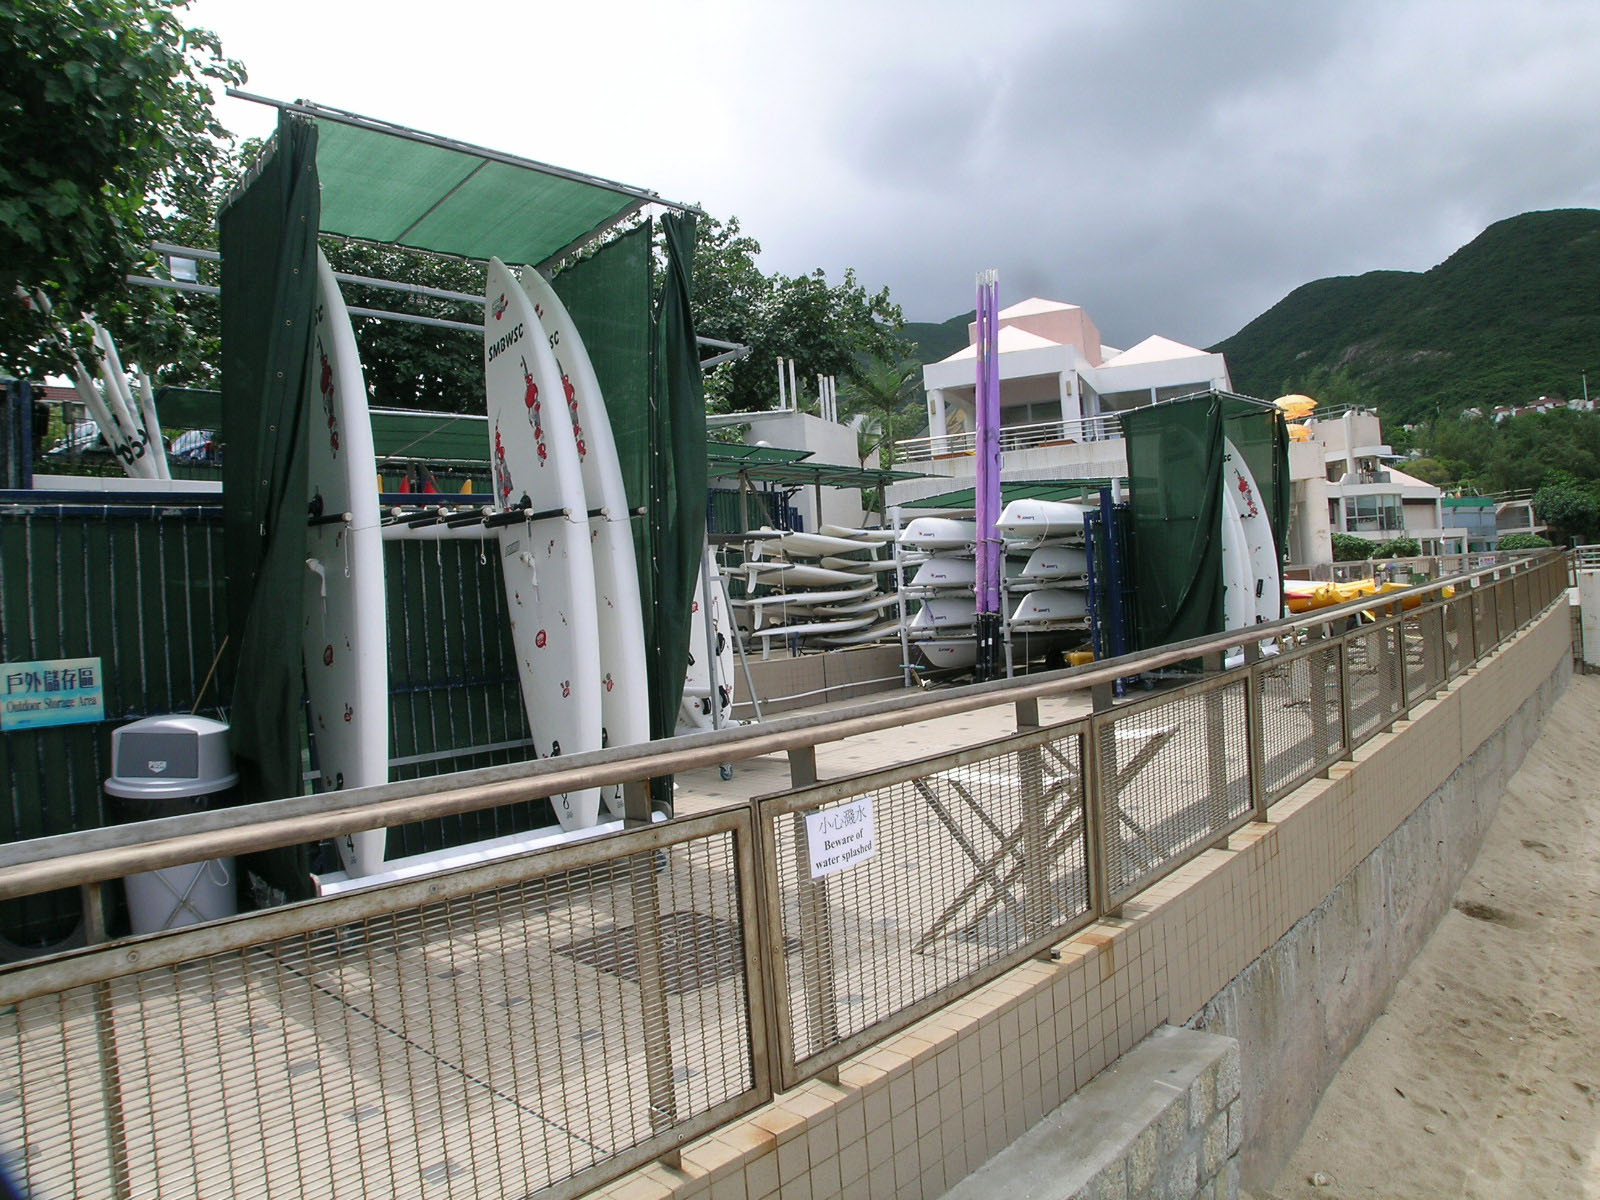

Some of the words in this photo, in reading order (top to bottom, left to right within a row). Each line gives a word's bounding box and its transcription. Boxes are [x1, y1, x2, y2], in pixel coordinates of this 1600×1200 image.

[488, 322, 524, 362] SMBWSC
[7, 700, 41, 713] Outdoor
[44, 697, 75, 710] Storage
[80, 696, 97, 707] Area
[824, 834, 854, 851] Beware
[856, 828, 864, 840] of
[816, 854, 841, 870] water
[842, 841, 872, 862] splashed
